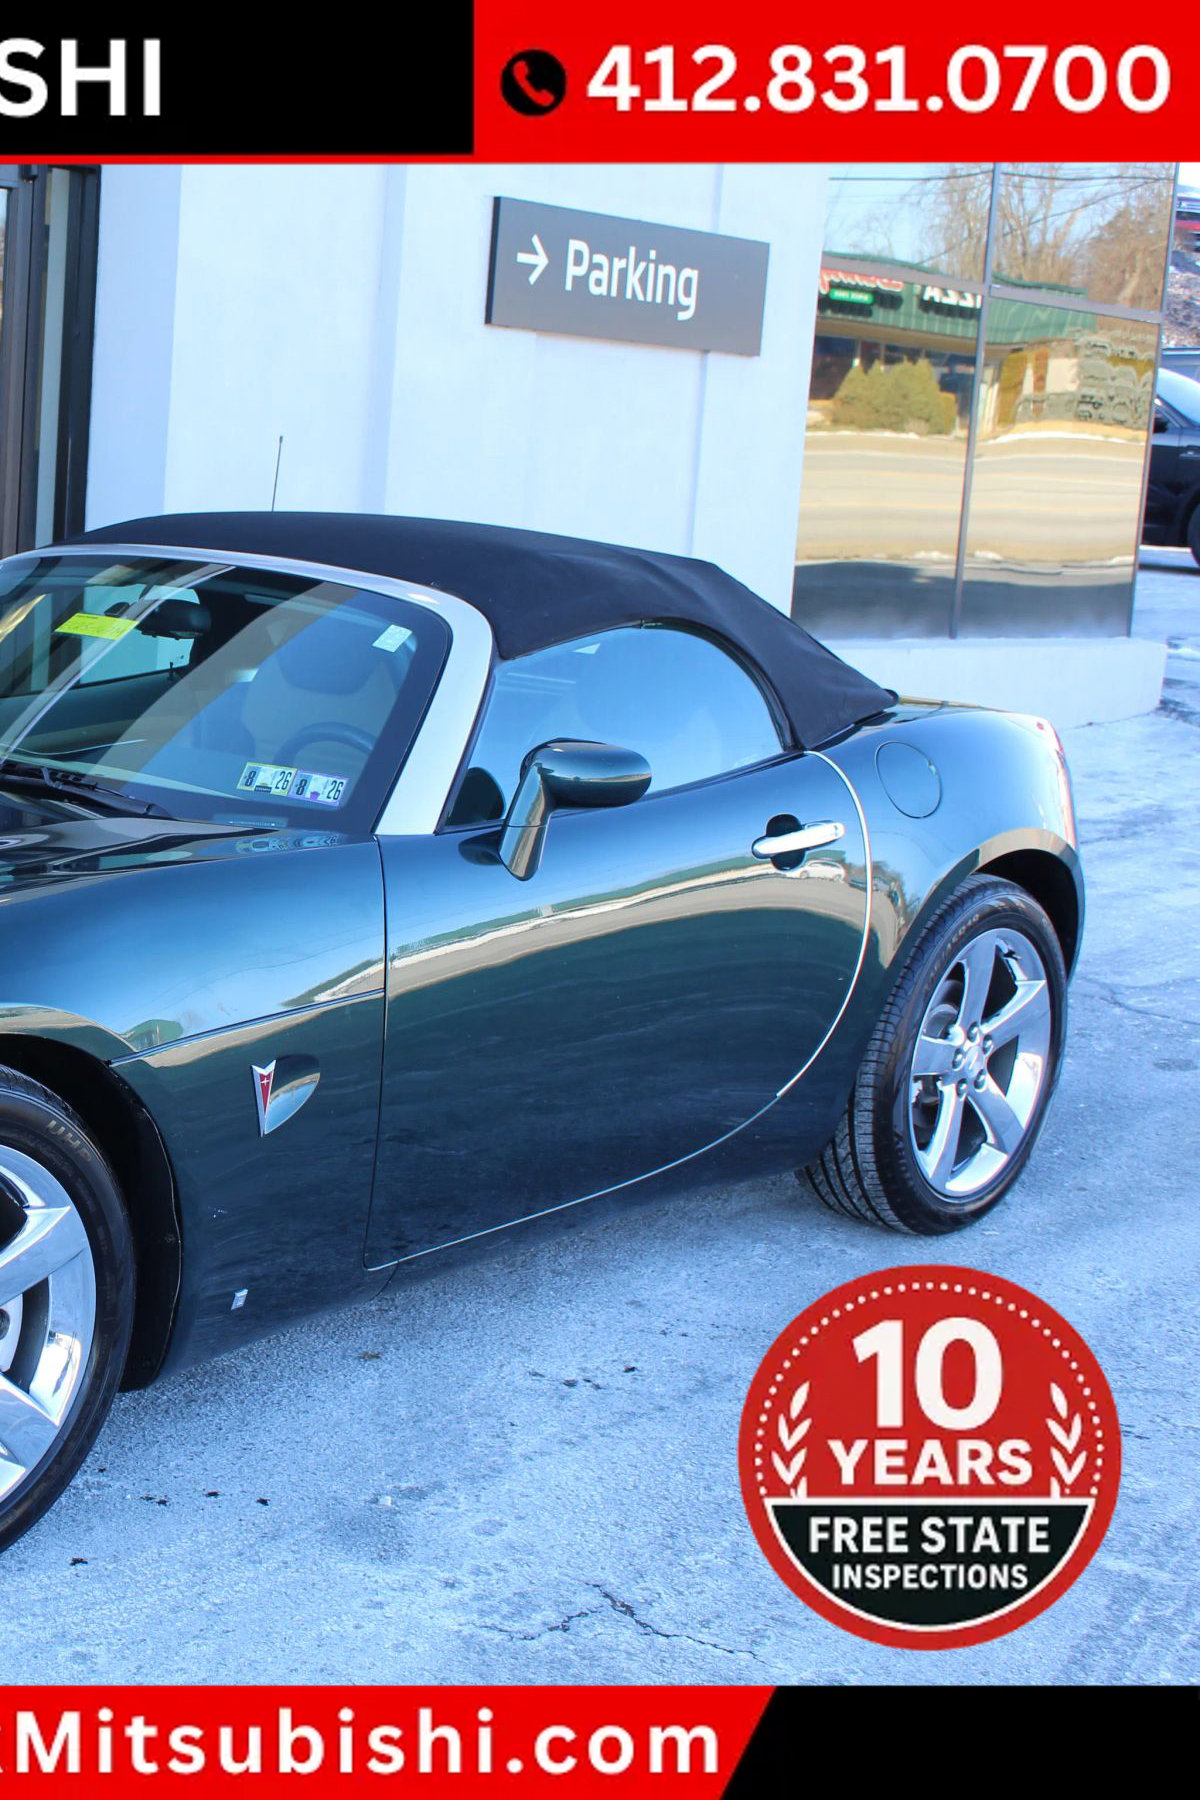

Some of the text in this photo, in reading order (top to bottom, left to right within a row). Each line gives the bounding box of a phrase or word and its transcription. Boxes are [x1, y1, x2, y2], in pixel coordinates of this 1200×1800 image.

[565, 238, 699, 321] Parking
[244, 771, 257, 787] 8
[275, 770, 292, 790] 26
[296, 778, 344, 800] 8 26
